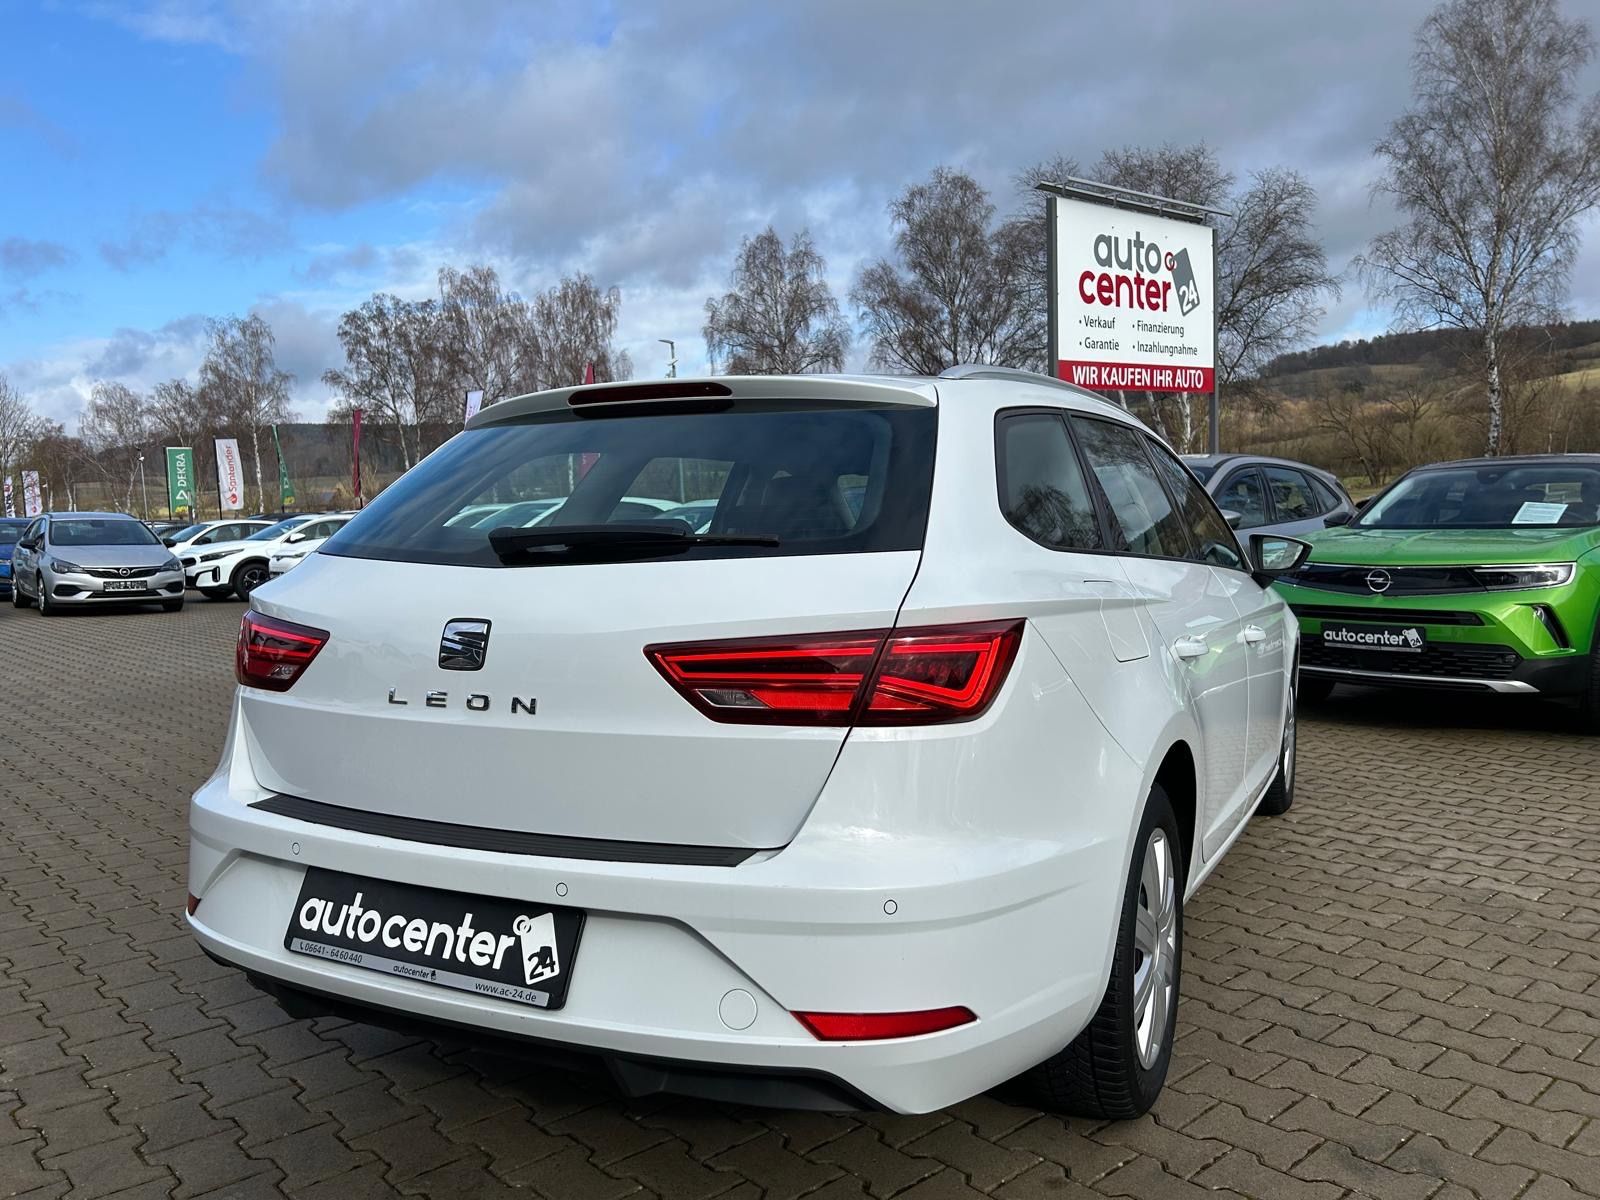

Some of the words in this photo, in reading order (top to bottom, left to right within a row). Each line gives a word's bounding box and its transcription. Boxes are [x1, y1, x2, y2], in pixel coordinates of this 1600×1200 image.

[1093, 231, 1162, 274] auto
[1078, 270, 1172, 312] center
[1179, 279, 1198, 313] 24
[1083, 316, 1116, 329] Verkauf
[1137, 321, 1185, 338] Finanzierung
[1084, 338, 1120, 351] Garantie
[1137, 342, 1198, 356] Inzahlungnahme
[1072, 365, 1099, 385] WIR
[1101, 366, 1151, 387] KAUFEN
[1153, 369, 1173, 388] IHR
[1174, 369, 1204, 389] AUTO
[176, 453, 187, 487] DEKRA
[225, 445, 237, 493] Santander
[1323, 627, 1405, 645] autocenter
[1410, 638, 1421, 647] 24
[387, 686, 537, 716] LEON
[298, 891, 516, 970] autocenter
[527, 945, 556, 980] 24
[393, 964, 430, 980] autocenter
[475, 982, 537, 1003] www.ac-24.de
